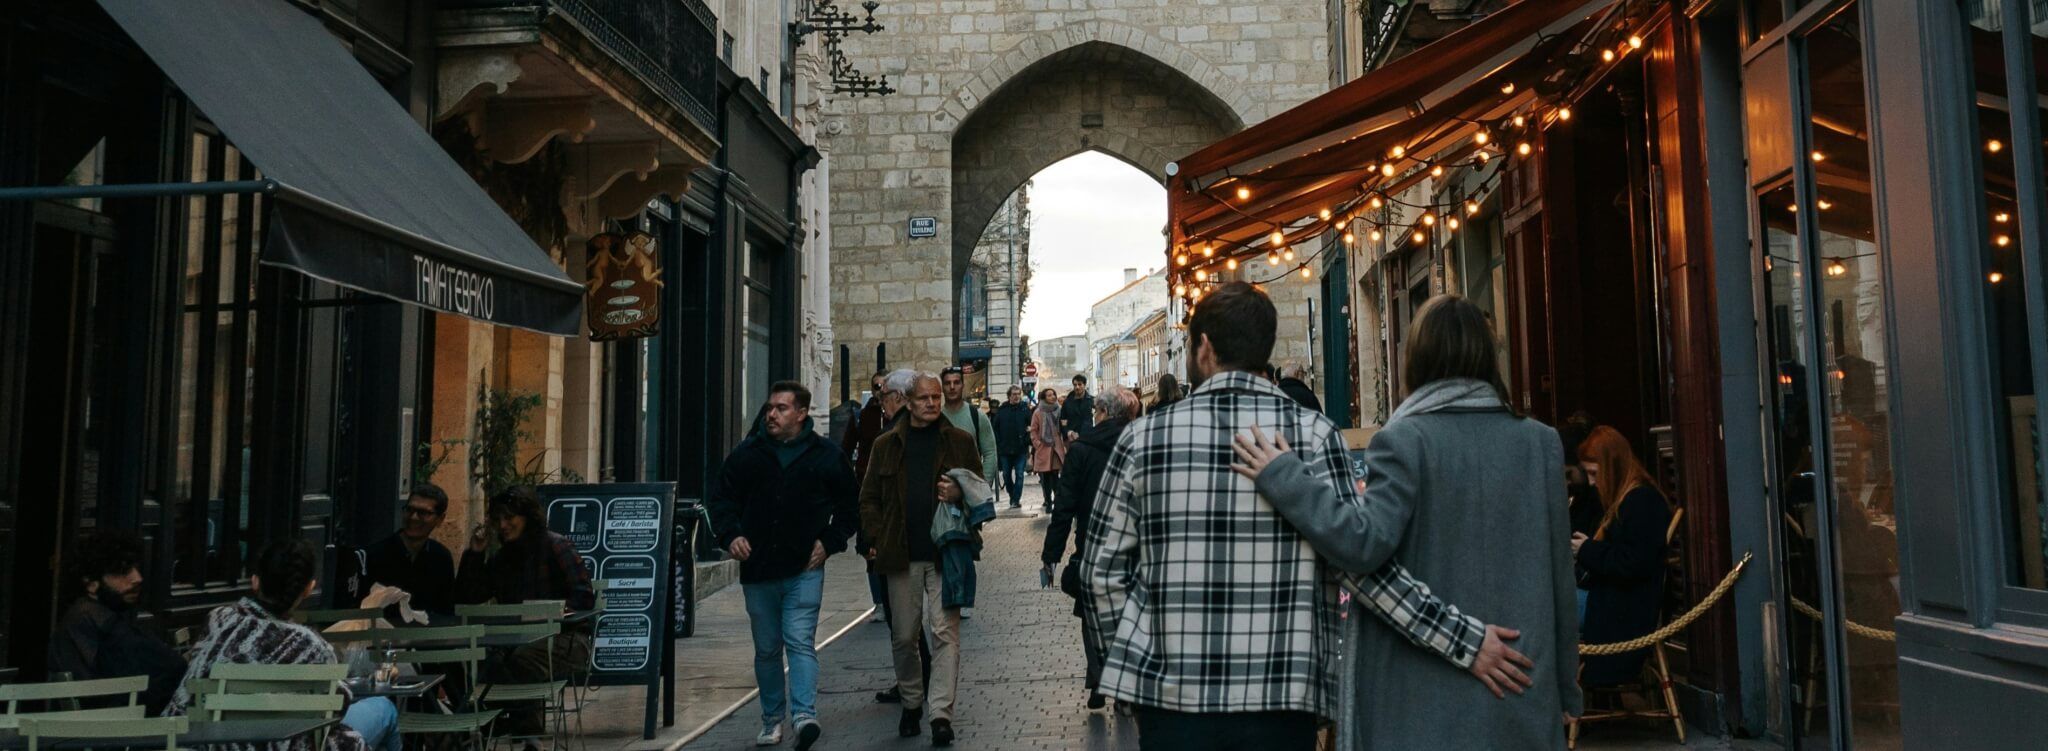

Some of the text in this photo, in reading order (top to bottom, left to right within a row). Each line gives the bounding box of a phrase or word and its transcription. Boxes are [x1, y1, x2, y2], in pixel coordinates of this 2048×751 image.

[413, 254, 494, 320] TAMATEBAKO
[562, 504, 587, 532] T
[608, 638, 638, 646] Boutique
